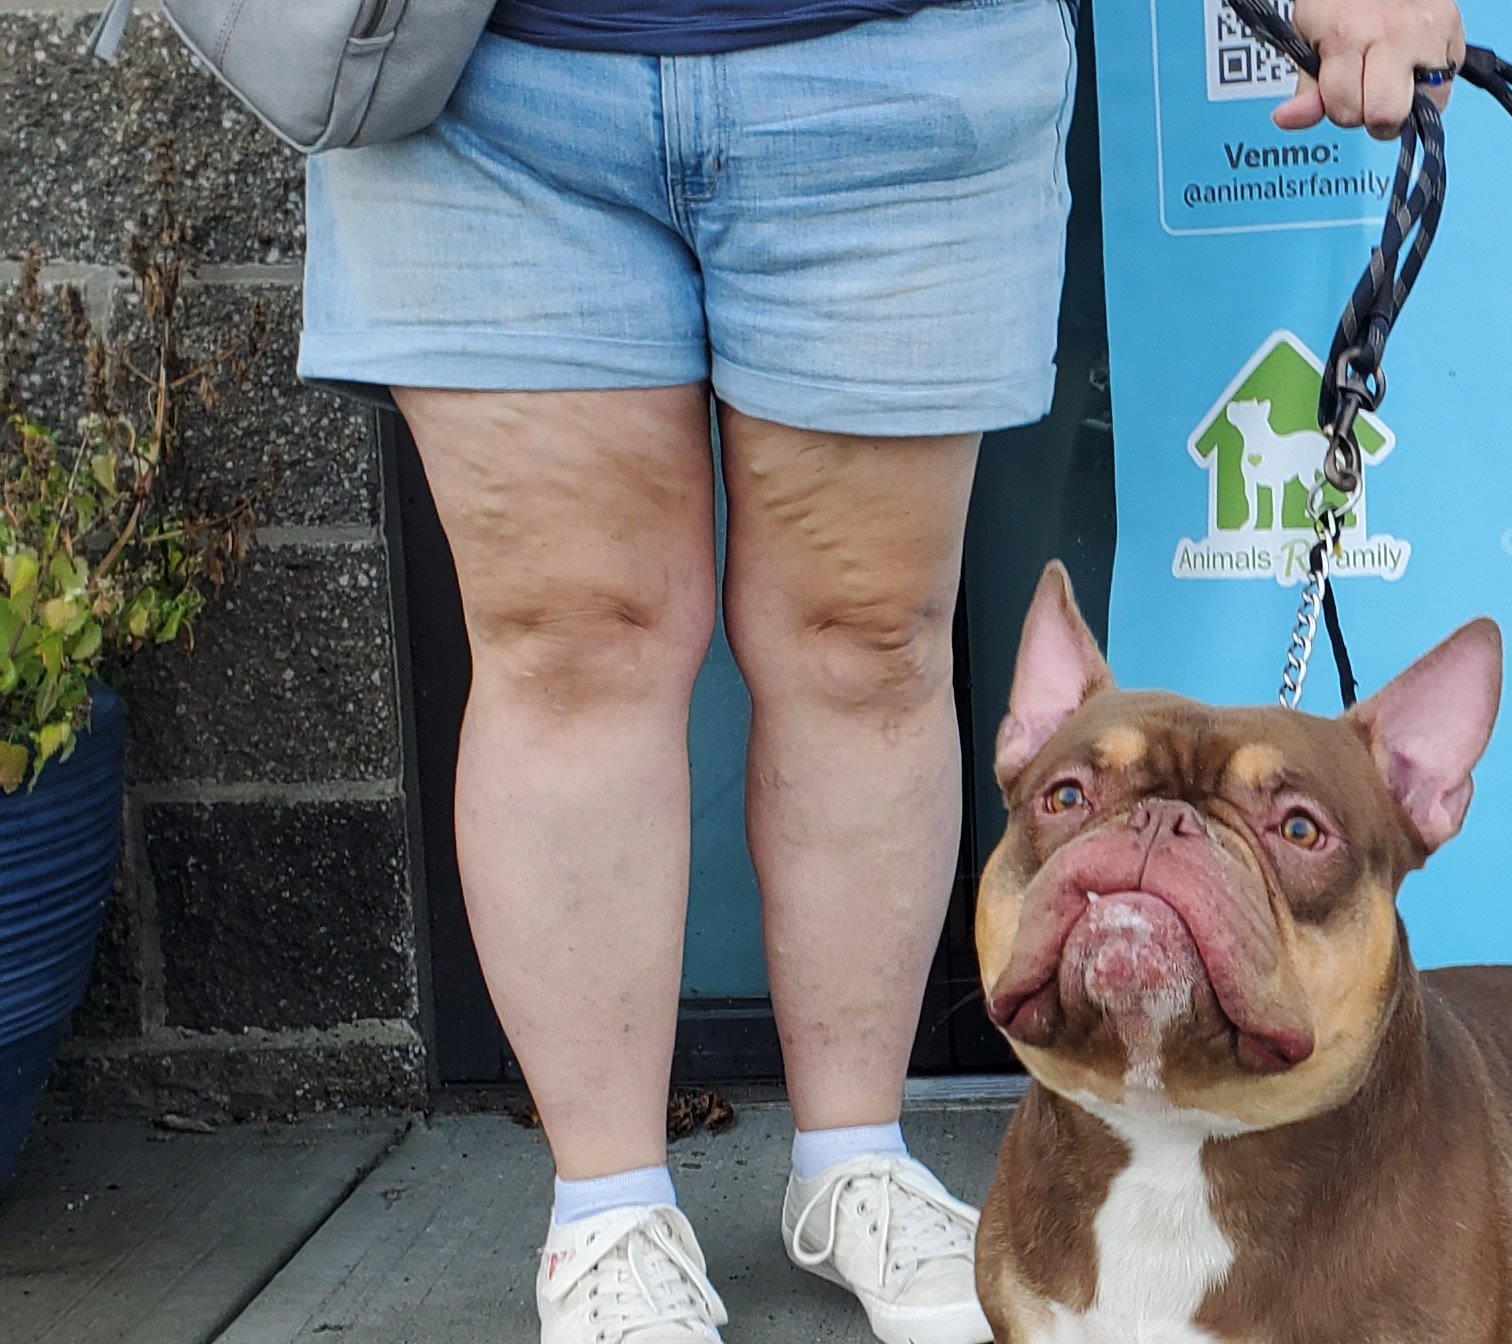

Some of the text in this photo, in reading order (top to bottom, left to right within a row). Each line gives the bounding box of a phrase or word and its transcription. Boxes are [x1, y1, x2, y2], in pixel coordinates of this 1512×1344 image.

[1223, 141, 1340, 170] Venmo:
[1183, 169, 1391, 209] @animalsrfamily
[1178, 545, 1272, 571] Animals
[1331, 542, 1402, 573] amily
